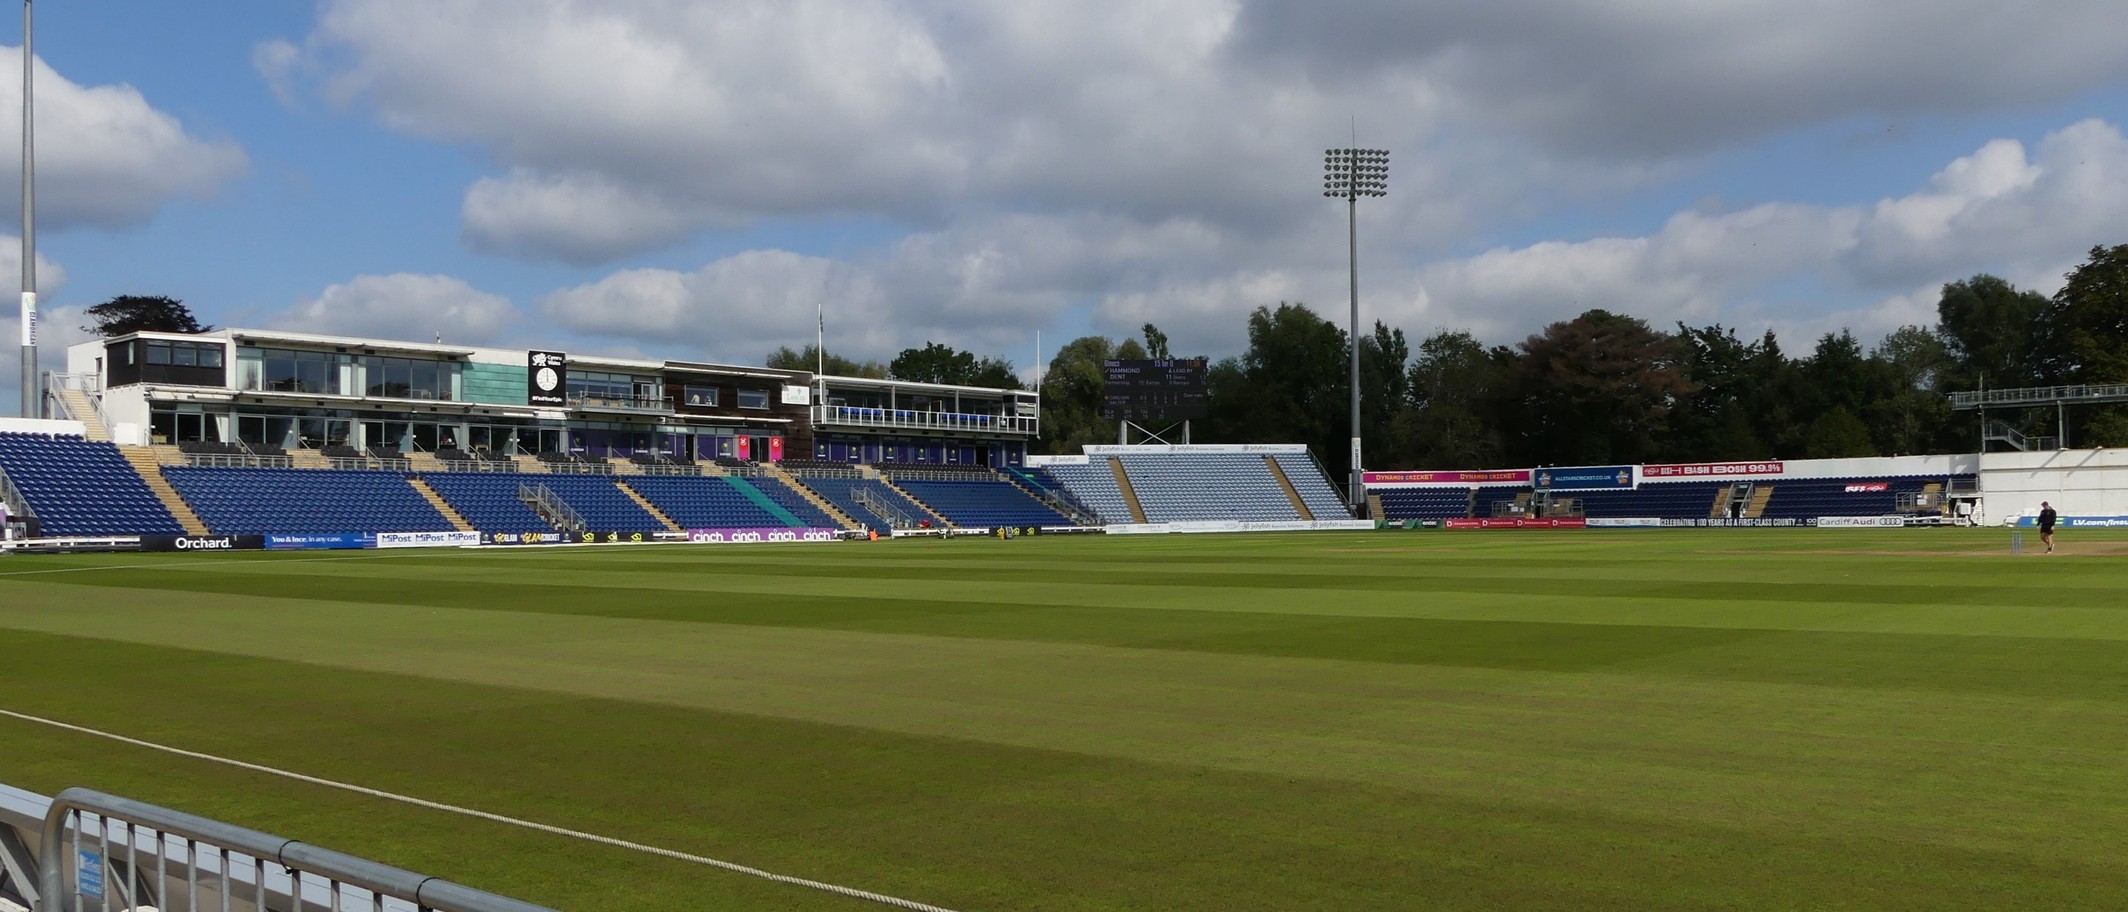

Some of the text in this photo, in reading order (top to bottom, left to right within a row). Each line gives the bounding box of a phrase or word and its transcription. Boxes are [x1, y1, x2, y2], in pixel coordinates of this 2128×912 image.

[1684, 465, 1710, 474] BASH
[1712, 464, 1747, 474] BOSH
[1748, 463, 1780, 473] 99.9%
[1660, 518, 1695, 527] CELEBRATING
[1697, 518, 1707, 527] 100
[1707, 518, 1725, 526] YEARS
[1725, 518, 1733, 526] AS
[1733, 518, 1738, 526] A
[1739, 518, 1772, 526] FIRST-CLASS
[1773, 518, 1796, 526] COUNTY
[1820, 517, 1875, 525] Cardiff Audi
[381, 534, 412, 543] MiPost
[415, 534, 445, 542] MiPost
[448, 533, 477, 541] MiPost
[693, 530, 724, 542] cinch
[731, 529, 761, 541] cinch
[768, 528, 797, 541] cinch
[803, 528, 831, 540] cinch
[175, 537, 232, 549] Orchard.
